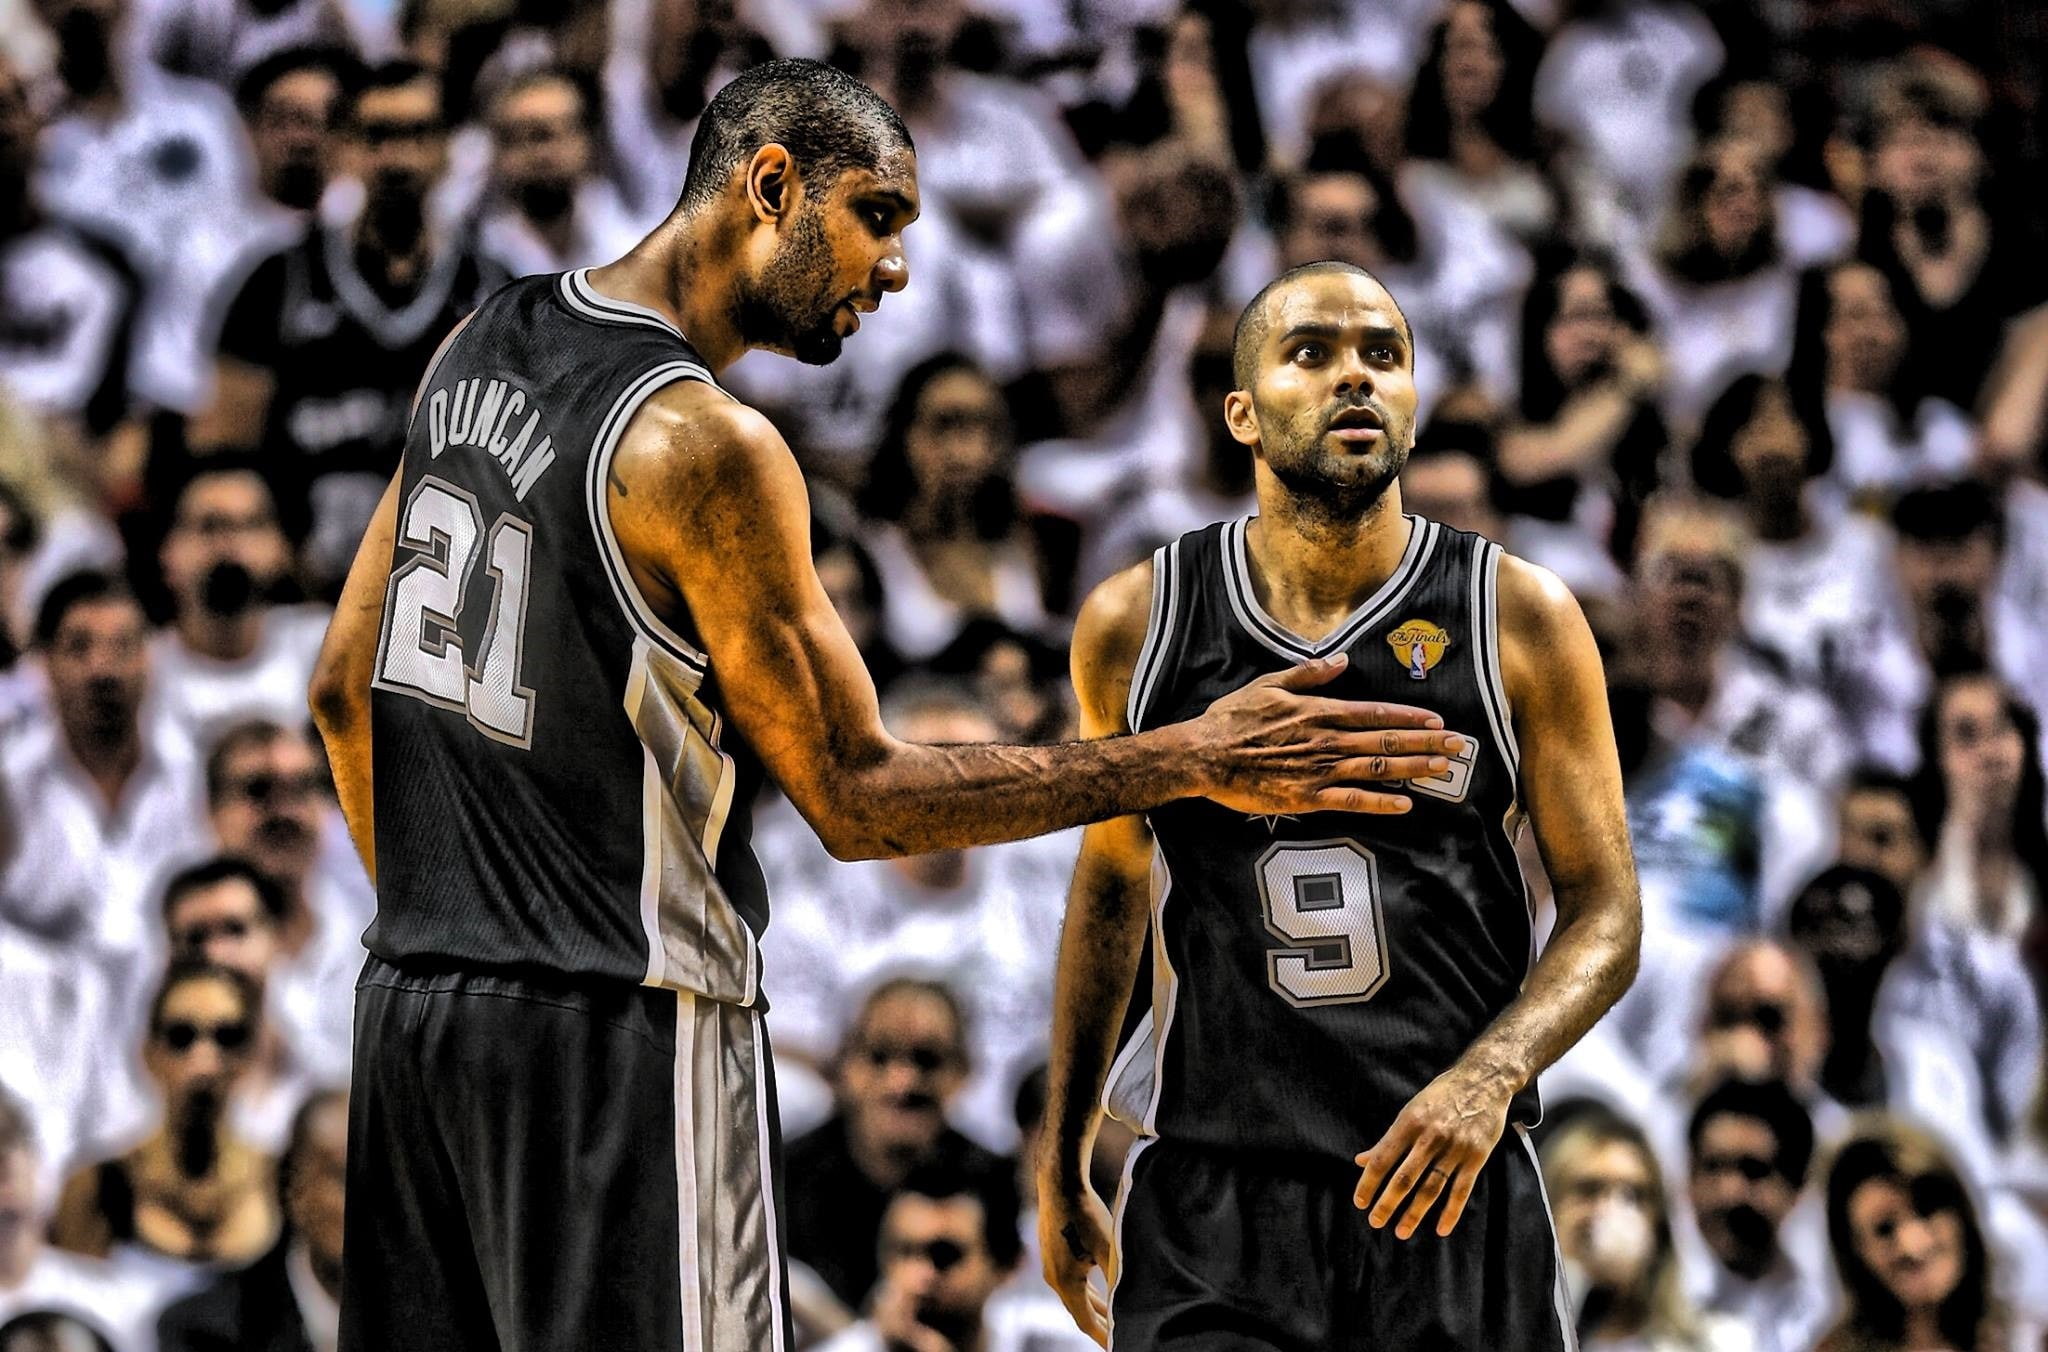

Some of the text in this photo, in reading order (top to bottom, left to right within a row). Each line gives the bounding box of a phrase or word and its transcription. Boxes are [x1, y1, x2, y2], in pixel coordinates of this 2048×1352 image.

[428, 377, 557, 503] DUNCAN
[371, 473, 537, 751] 21
[1406, 628, 1447, 645] Finals
[1255, 838, 1390, 1009] 9
